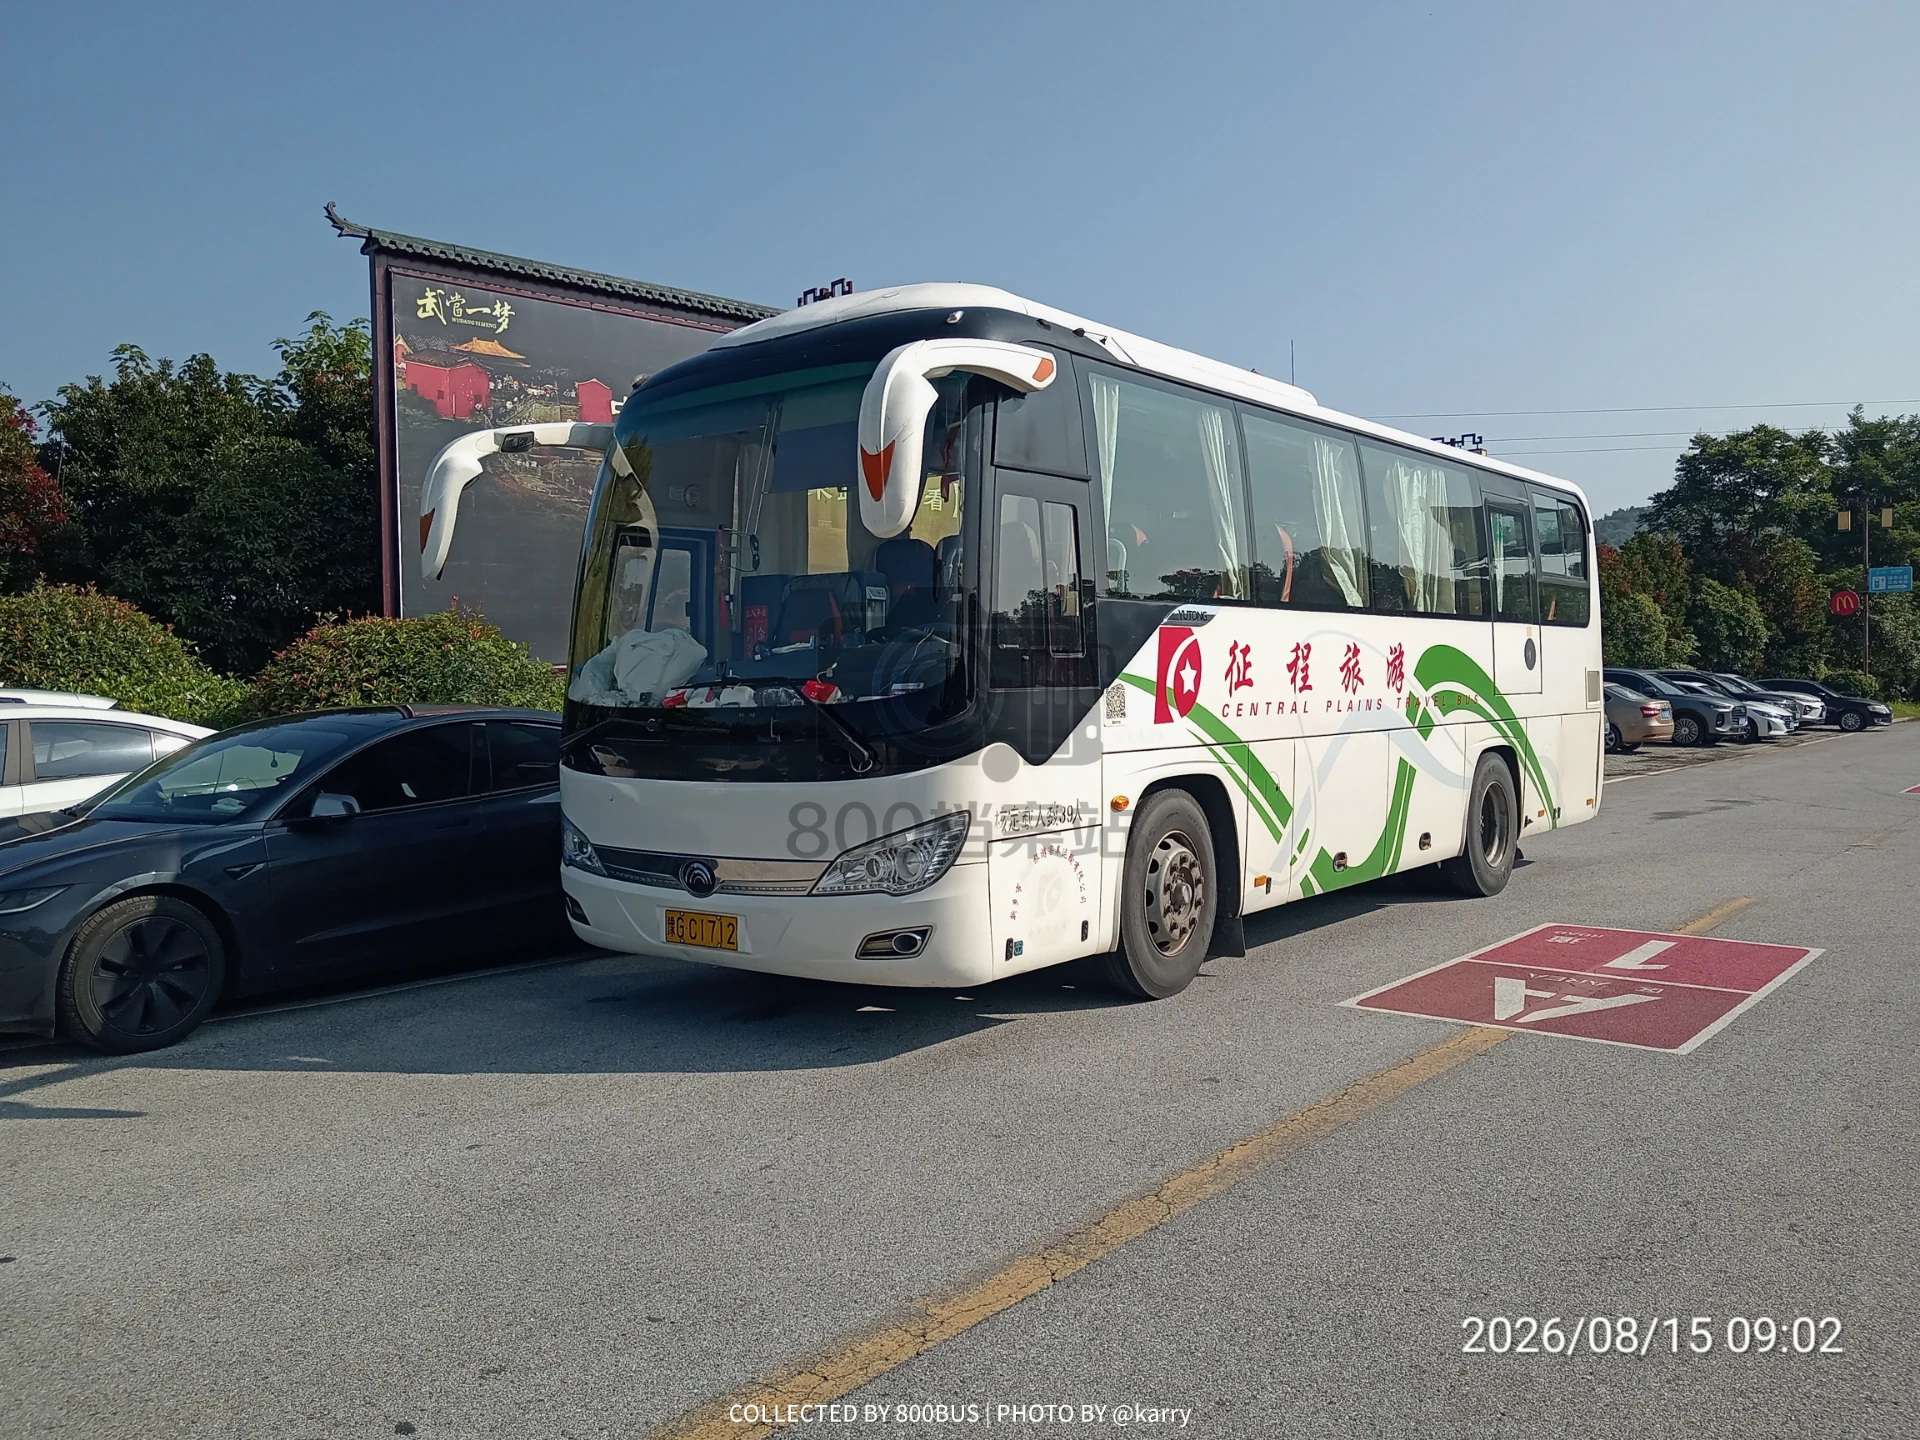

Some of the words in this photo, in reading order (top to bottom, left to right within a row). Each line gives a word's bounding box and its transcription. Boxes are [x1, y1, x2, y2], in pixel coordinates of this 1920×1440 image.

[1178, 610, 1208, 622] YUTONG
[1224, 639, 1405, 698] 征程旅游
[1221, 700, 1309, 718] CENTRAL
[1325, 698, 1383, 713] PLAINS
[1396, 696, 1446, 709] TRAVEL
[1457, 694, 1479, 706] BUS
